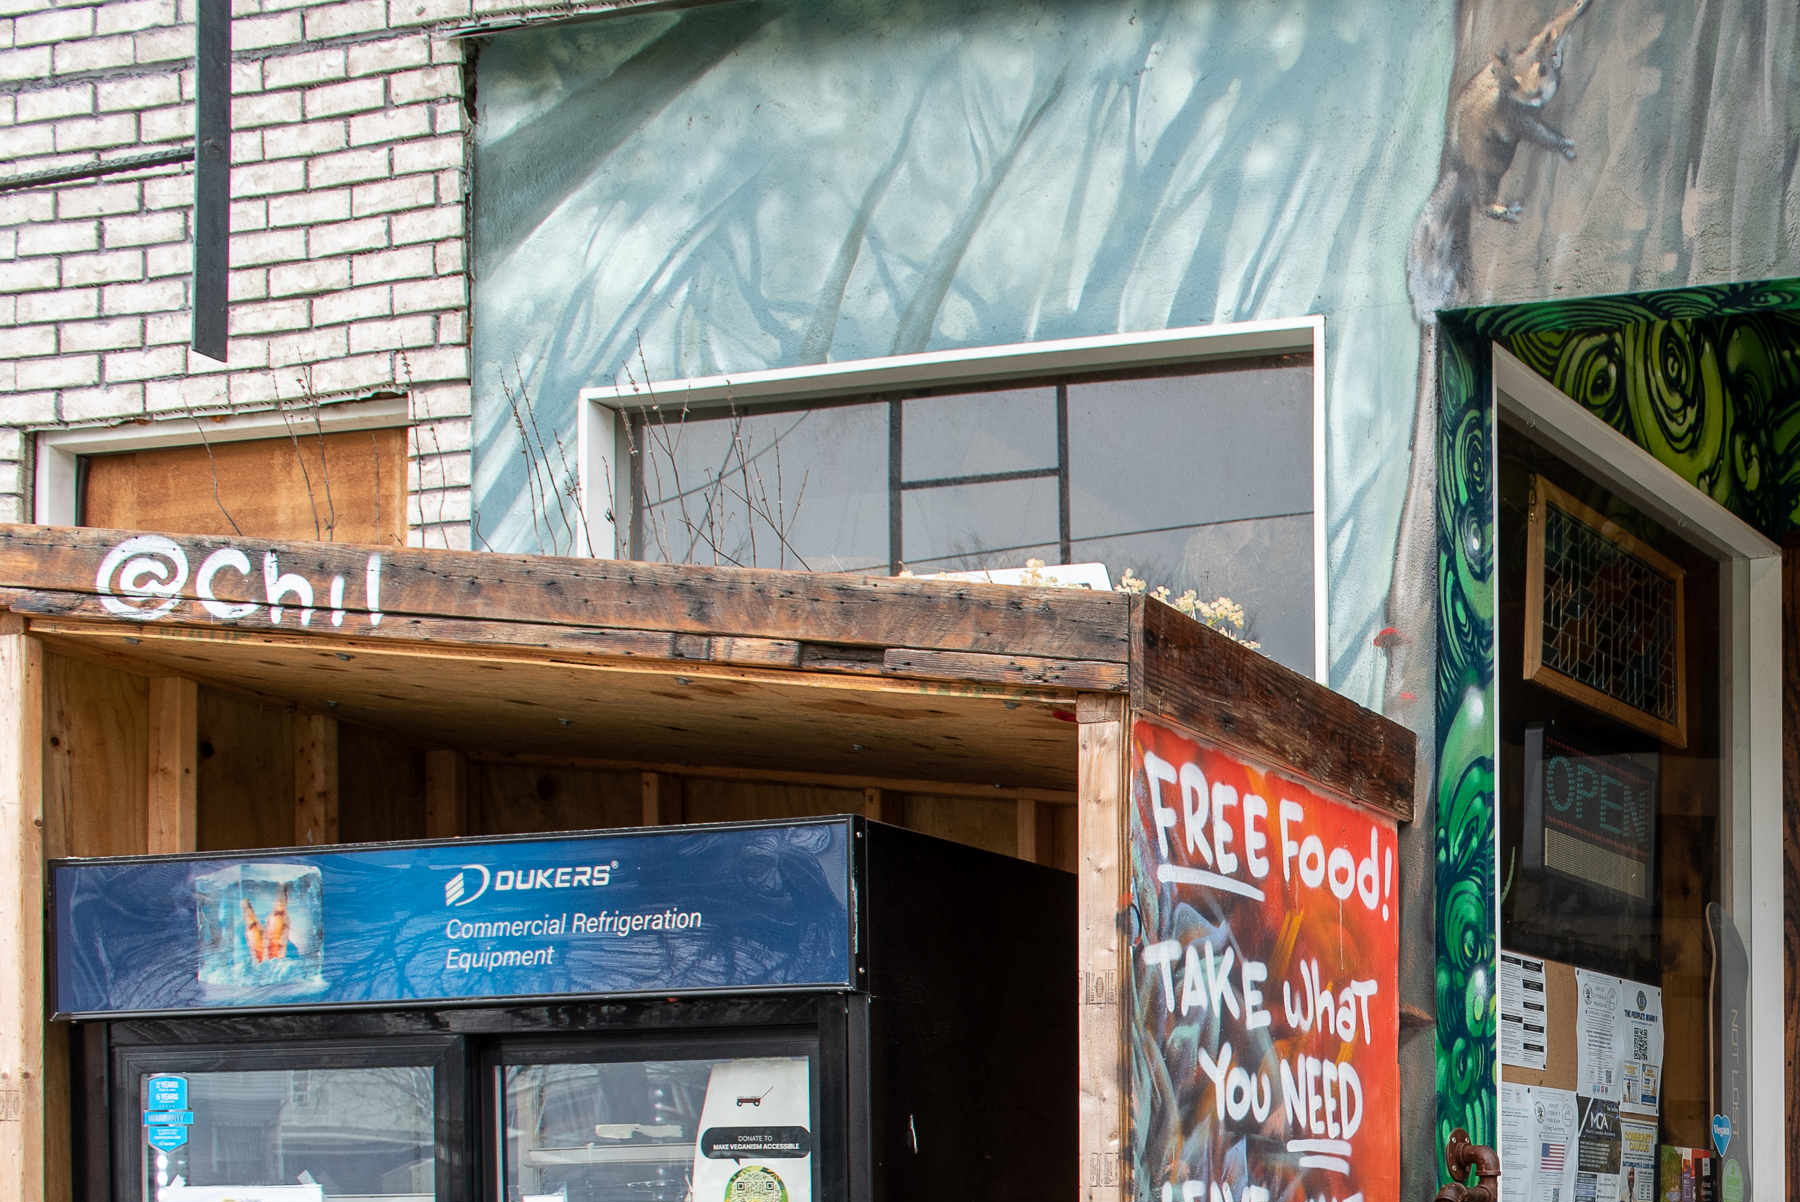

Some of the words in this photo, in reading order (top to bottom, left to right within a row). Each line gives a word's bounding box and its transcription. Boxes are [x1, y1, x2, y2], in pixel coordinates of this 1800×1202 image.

[96, 535, 384, 627] @Chil
[1143, 750, 1270, 879] FREE
[1546, 755, 1646, 843] OPEN
[446, 913, 567, 939] Commercial
[572, 907, 702, 937] Refrigeration
[446, 946, 555, 973] Equipment
[1141, 939, 1272, 1031] TAKE
[1731, 1008, 1739, 1065] NOT
[148, 1114, 187, 1122] WARRANTY
[1279, 1052, 1364, 1139] NEED
[1590, 1112, 1609, 1130] MCA
[1732, 1071, 1740, 1142] LOST
[1624, 1131, 1654, 1144] COMMUNITY
[1713, 1124, 1730, 1137] Vegan
